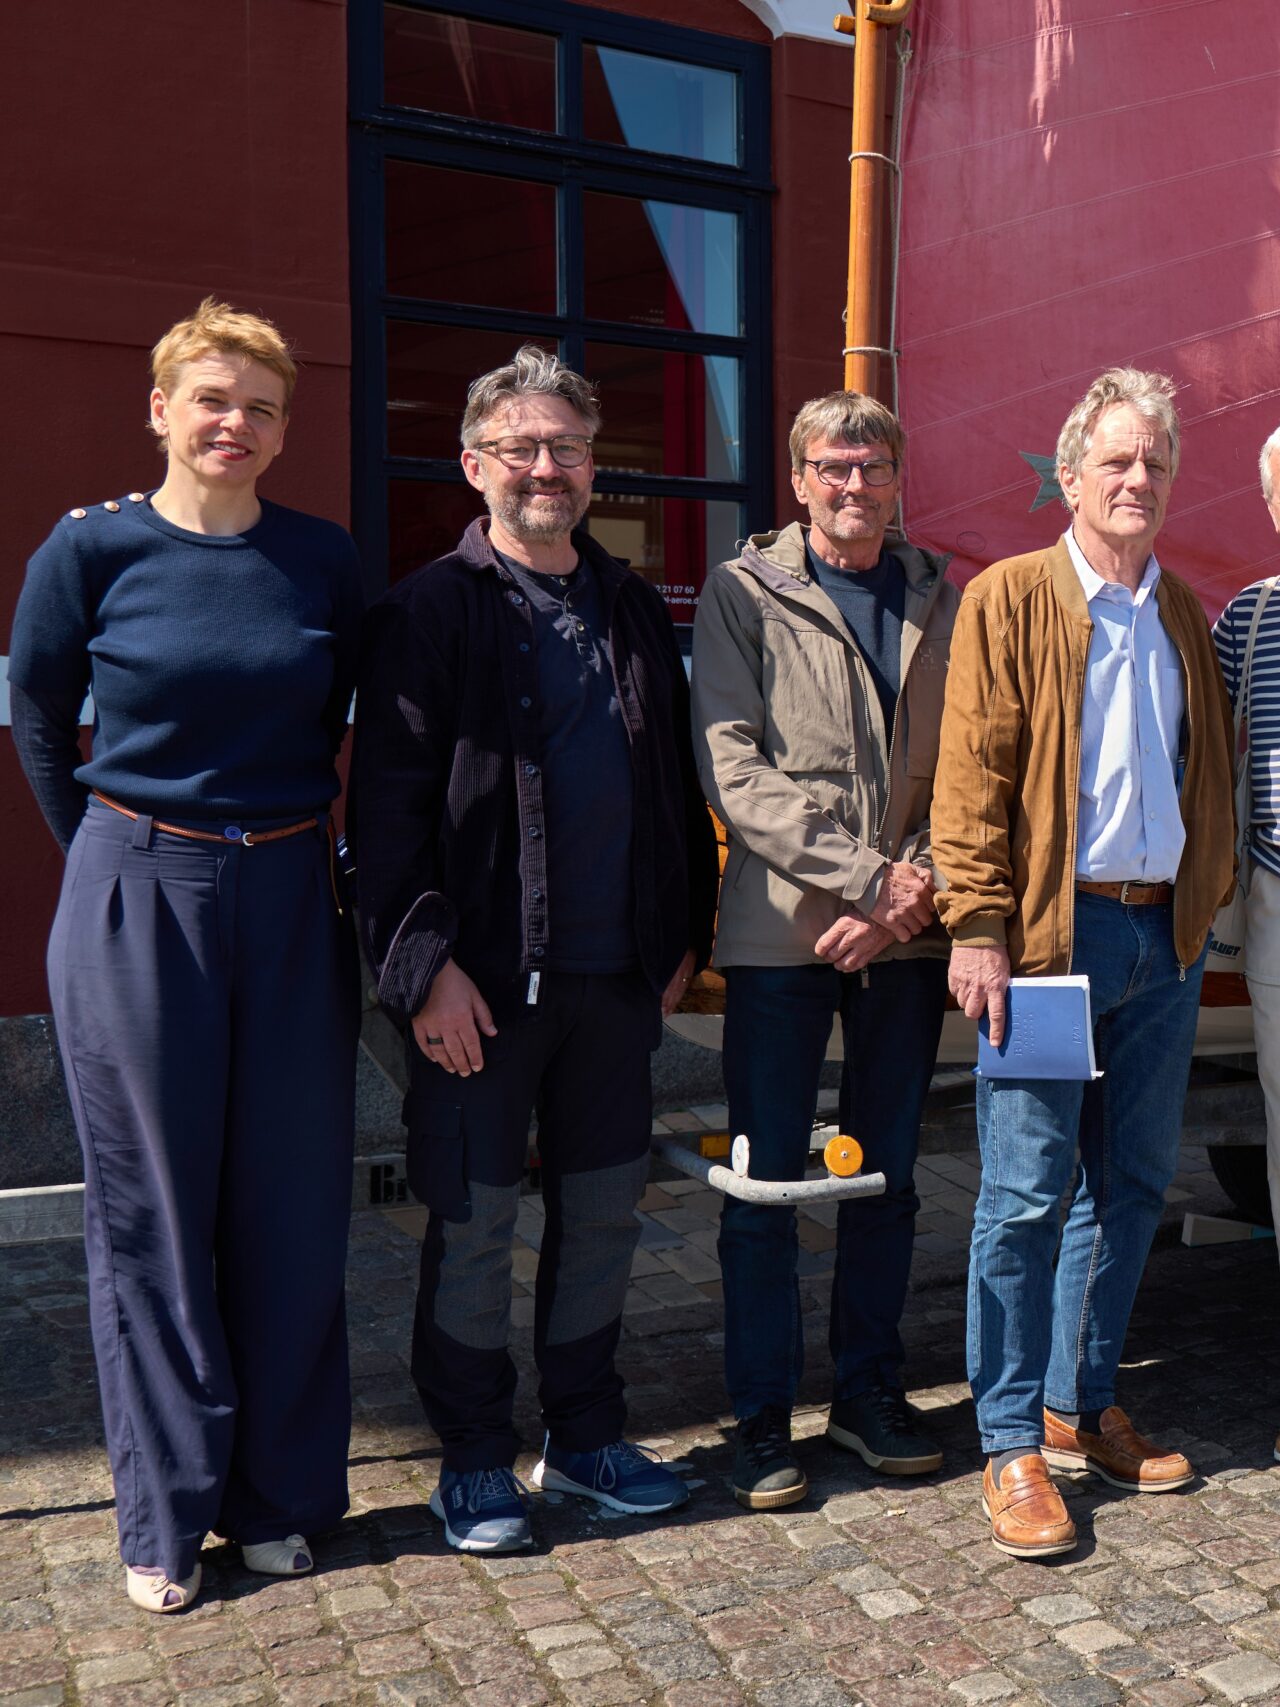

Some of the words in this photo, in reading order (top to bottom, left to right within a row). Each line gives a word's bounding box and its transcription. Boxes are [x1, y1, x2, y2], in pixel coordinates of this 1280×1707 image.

[662, 585, 672, 594] 21
[673, 585, 684, 594] 07
[684, 586, 695, 595] 60
